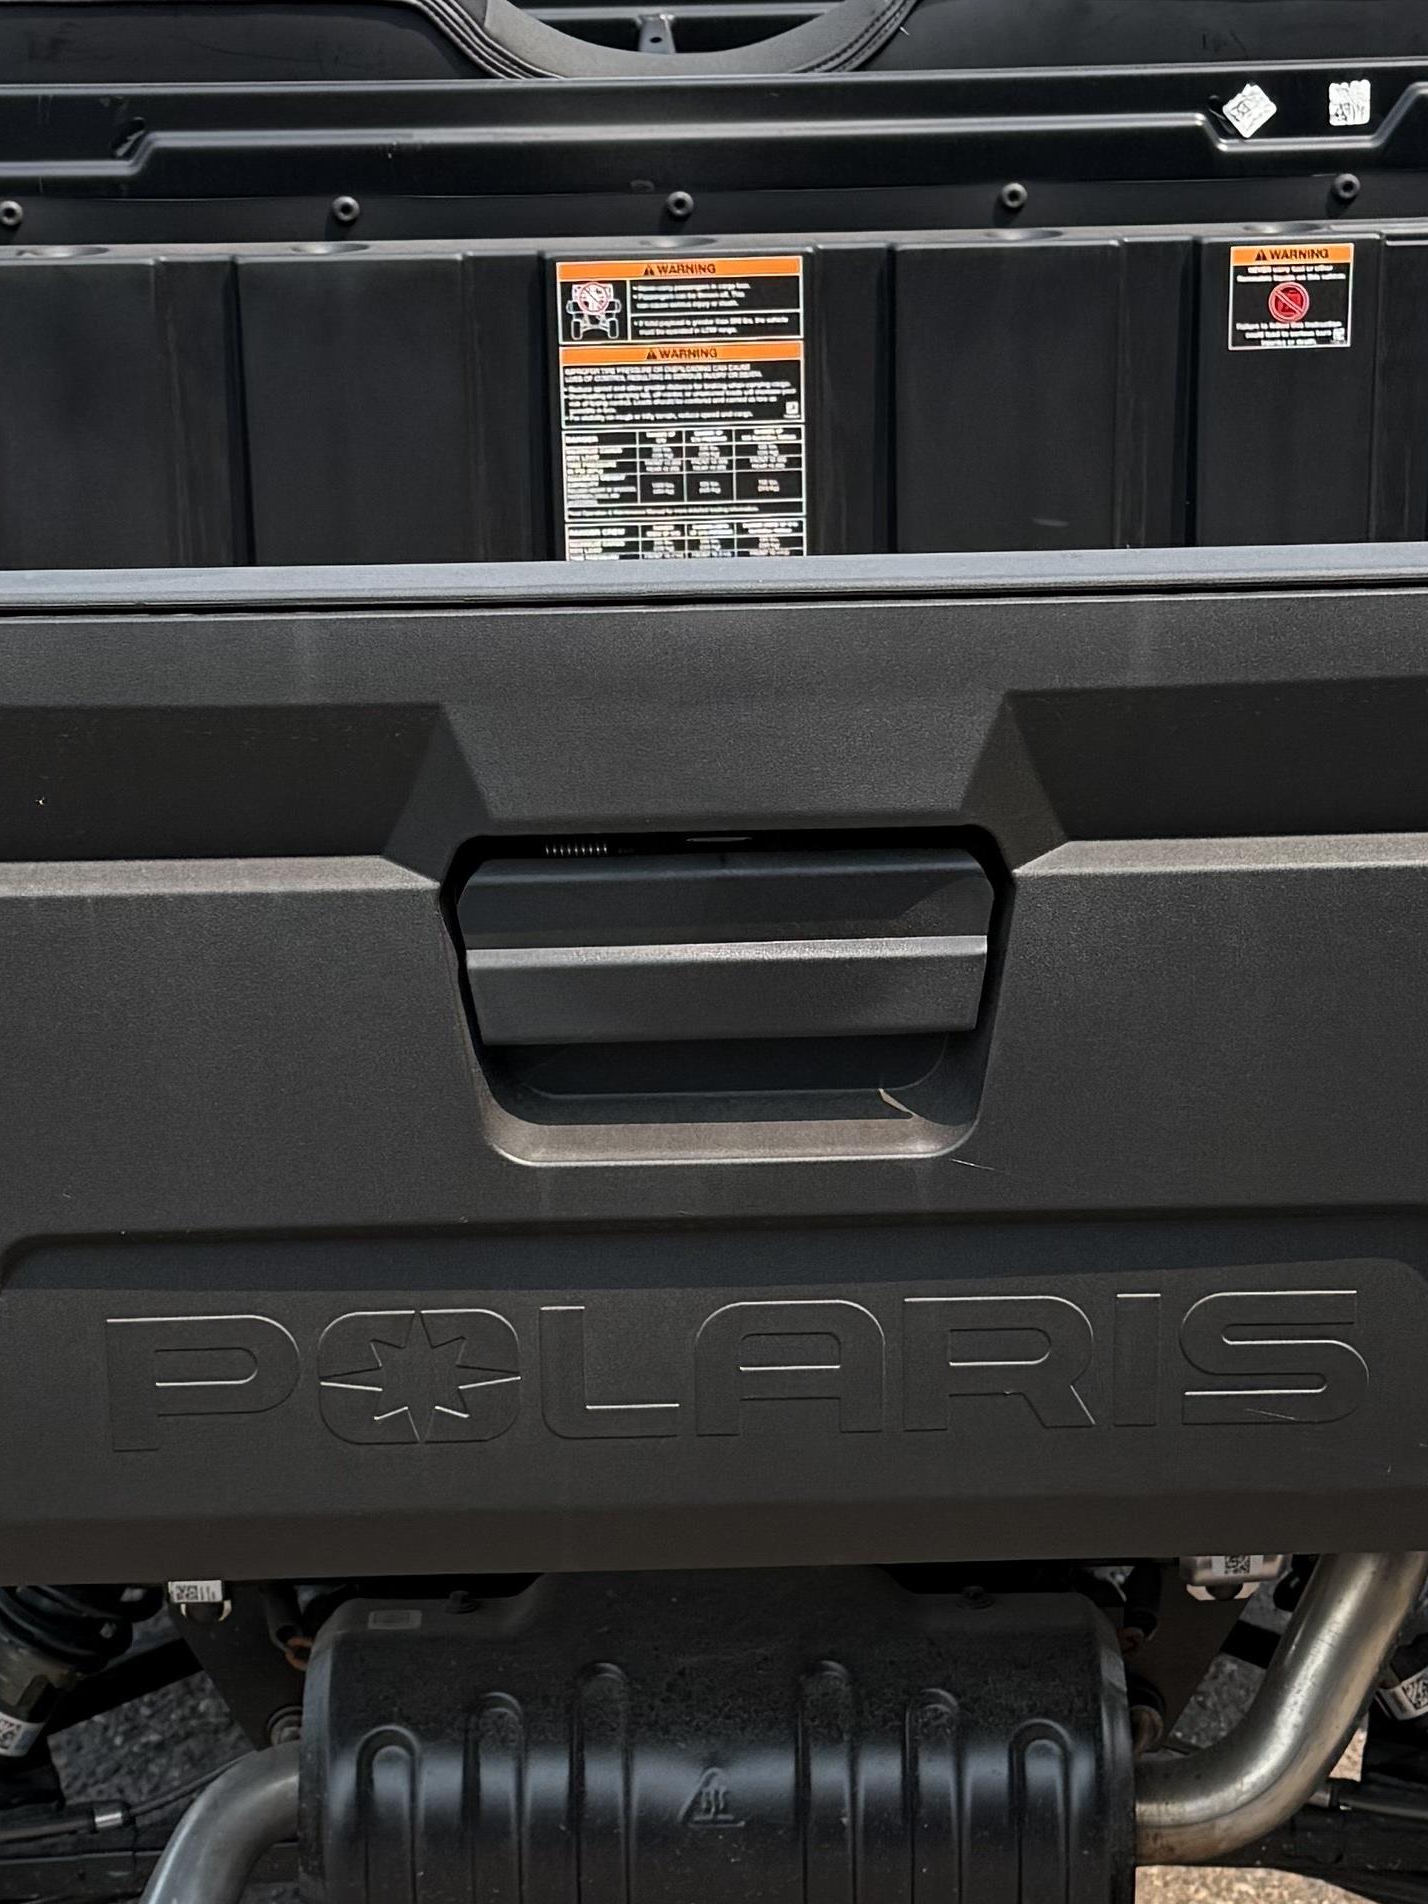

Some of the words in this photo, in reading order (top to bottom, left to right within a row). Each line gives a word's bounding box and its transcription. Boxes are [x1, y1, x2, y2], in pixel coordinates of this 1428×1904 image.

[1268, 248, 1330, 260] WARNING
[657, 263, 716, 275] WARNING
[659, 347, 718, 359] WARNING
[106, 1289, 1370, 1453] POLARIS
